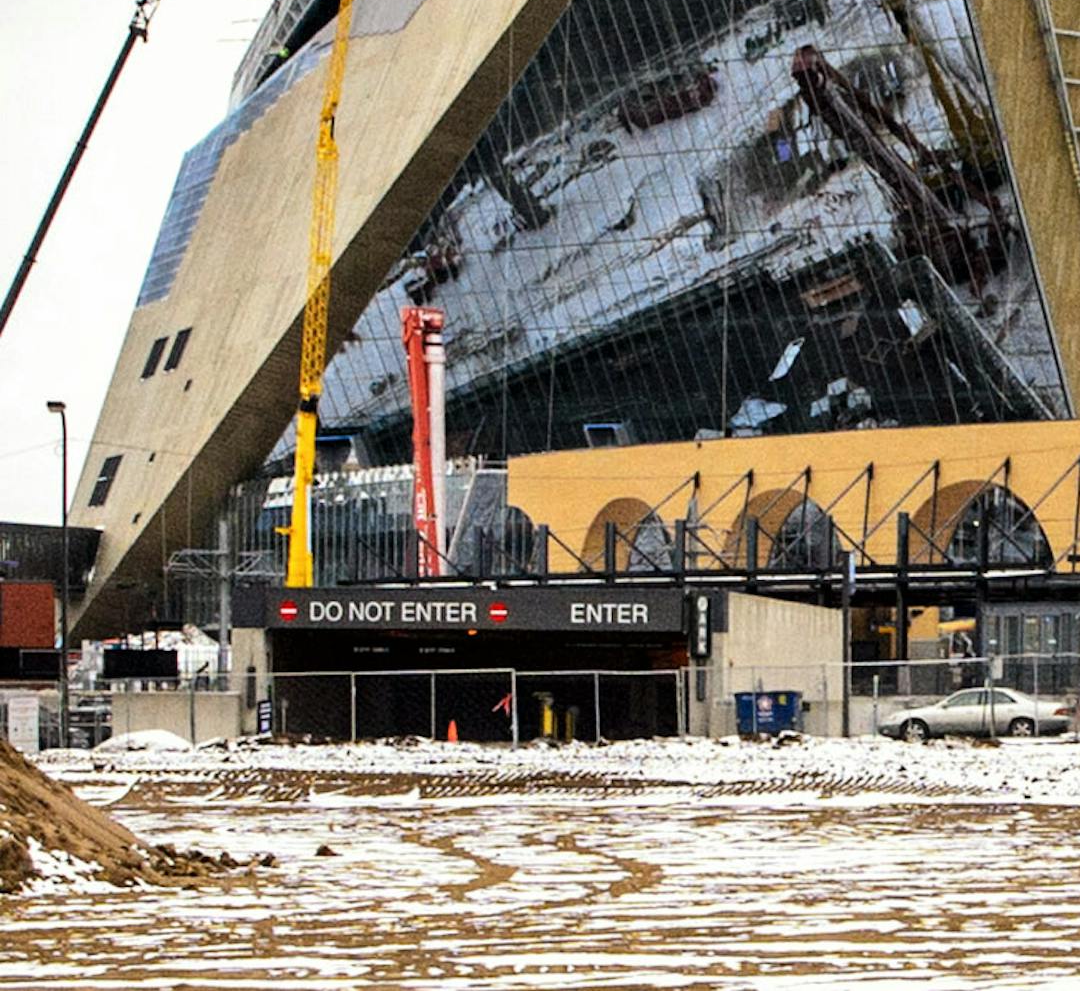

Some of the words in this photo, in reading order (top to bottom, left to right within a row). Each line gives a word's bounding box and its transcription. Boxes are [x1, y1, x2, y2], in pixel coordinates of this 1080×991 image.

[309, 601, 343, 622] DO
[349, 601, 395, 622] NOT
[401, 602, 477, 622] ENTER
[570, 603, 649, 624] ENTER
